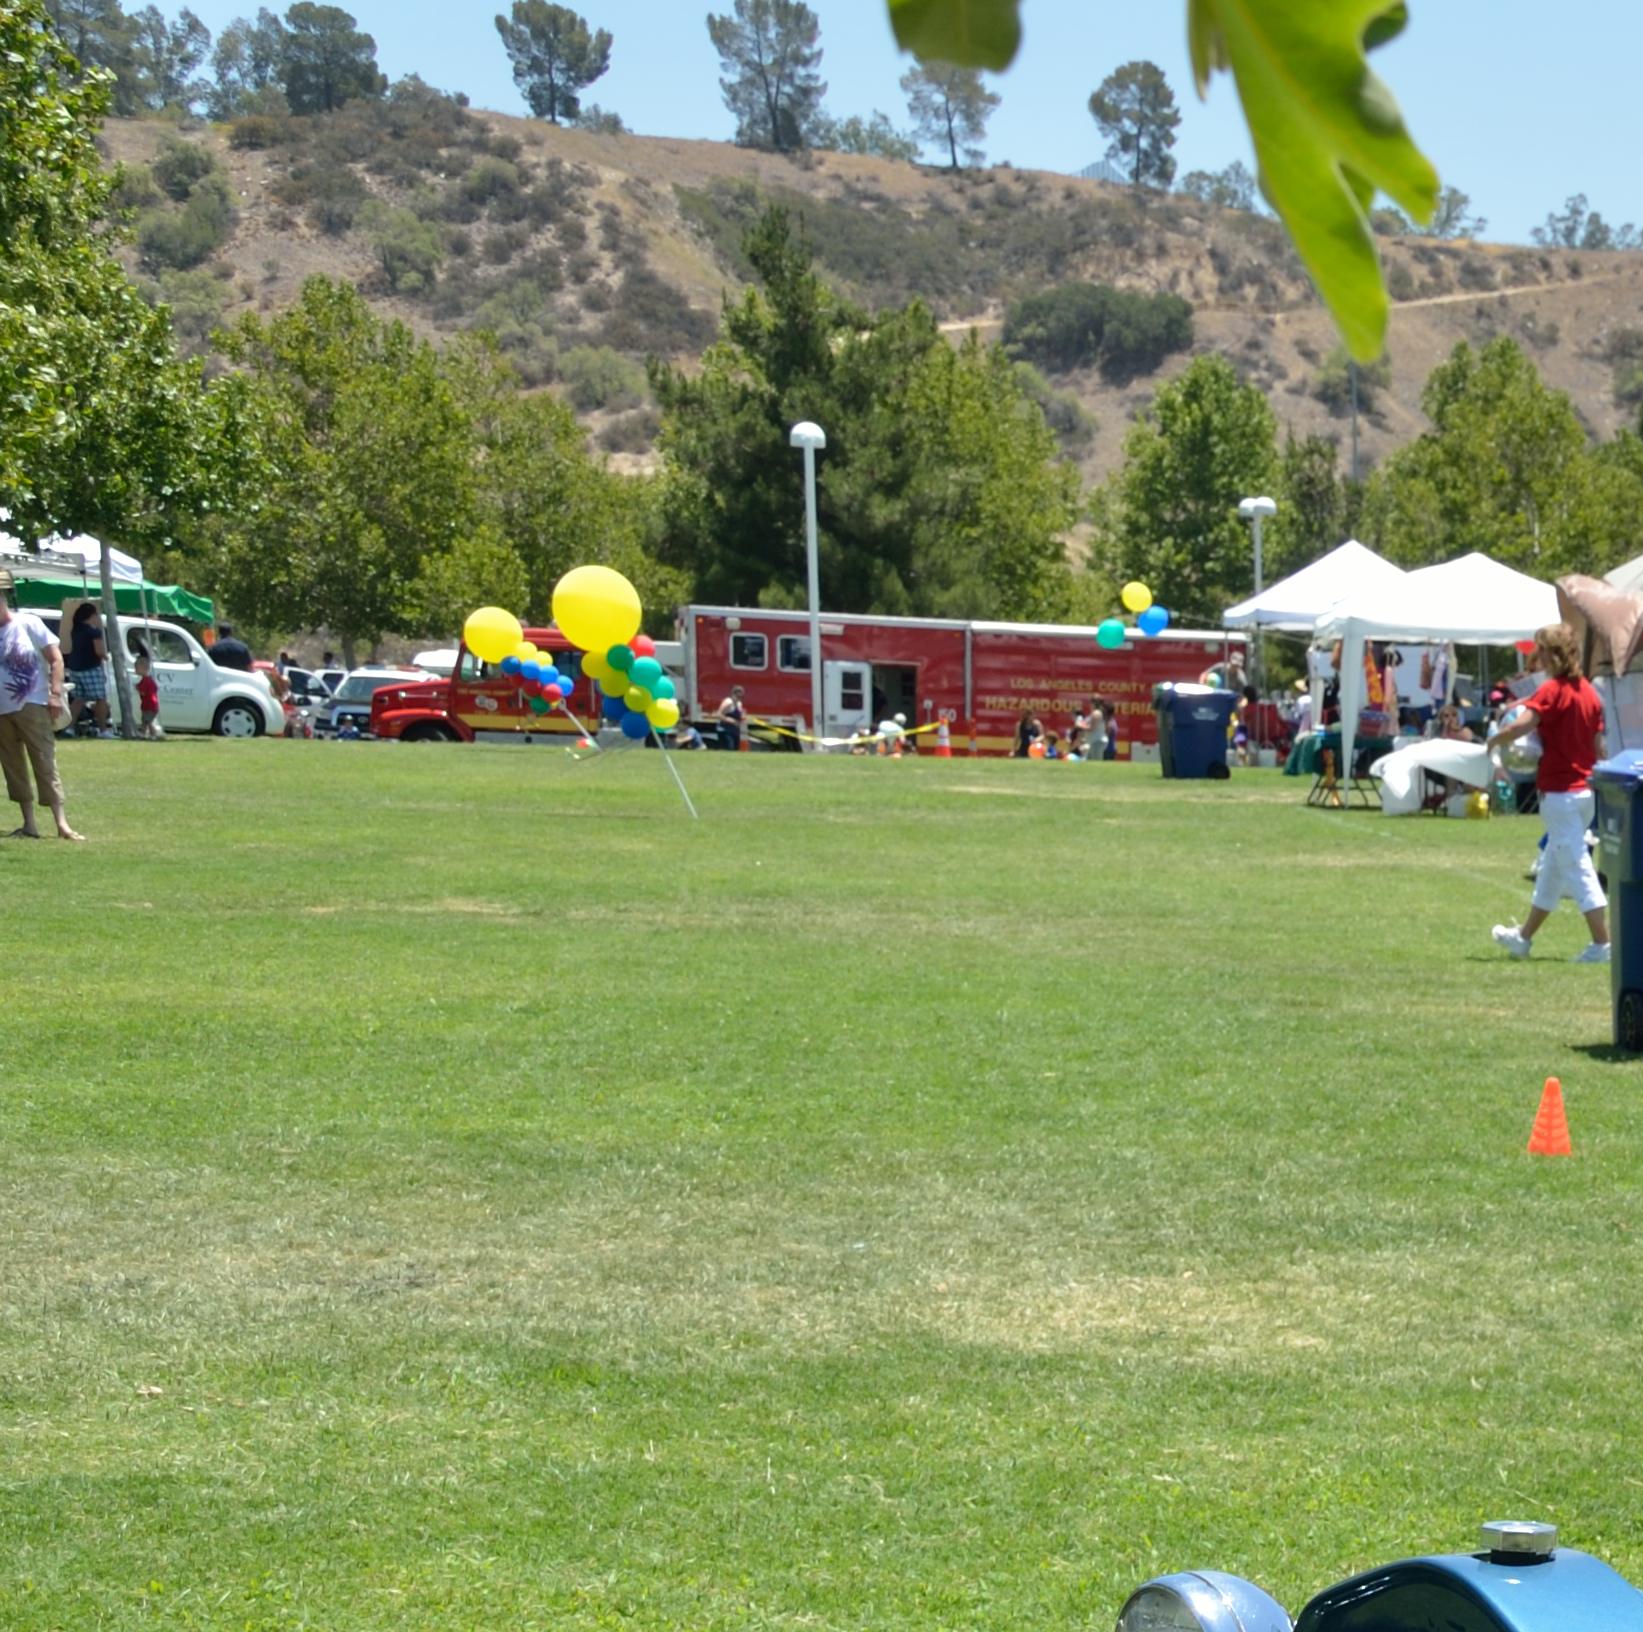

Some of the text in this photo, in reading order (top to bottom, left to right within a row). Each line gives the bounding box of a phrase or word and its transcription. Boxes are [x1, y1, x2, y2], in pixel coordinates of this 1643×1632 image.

[1010, 678, 1146, 693] LOS ANGELES COUNTY
[985, 696, 1082, 712] HAZARDOUS
